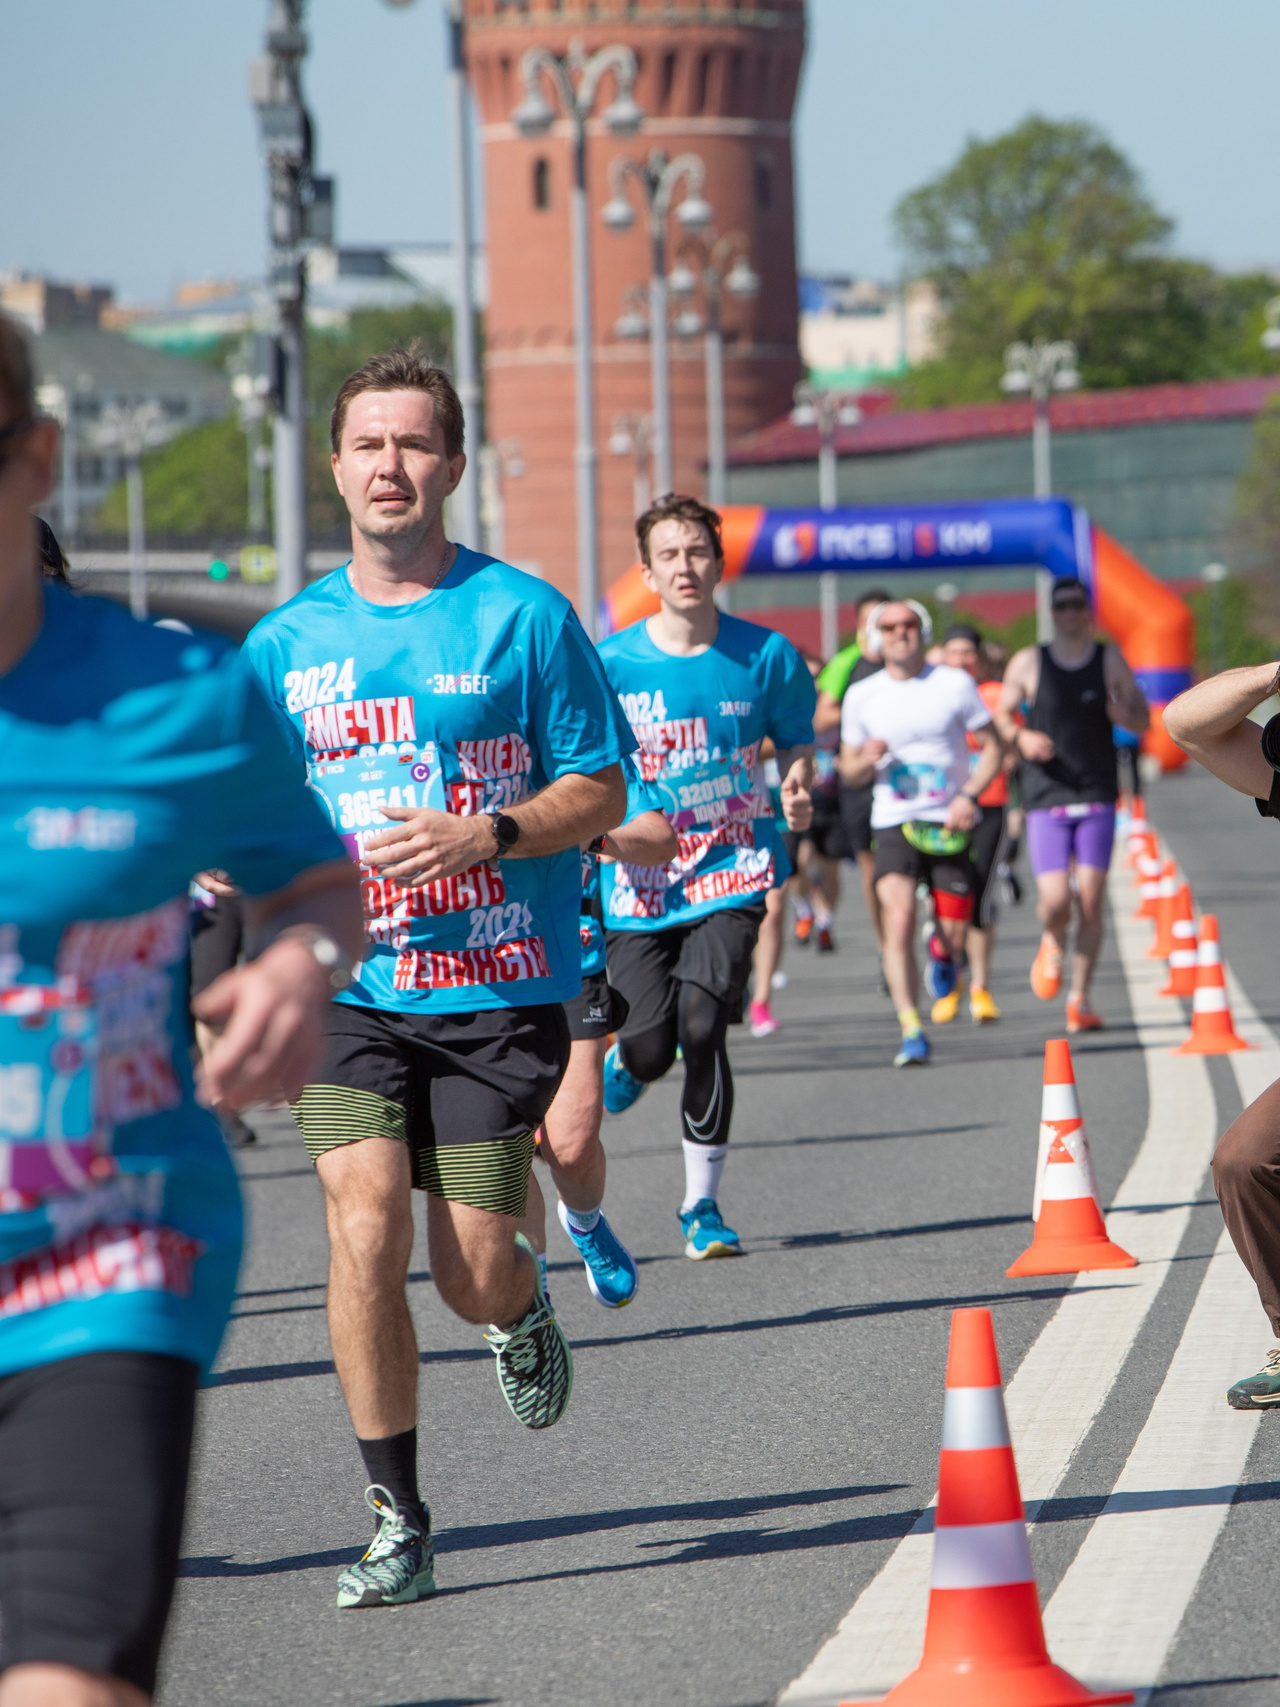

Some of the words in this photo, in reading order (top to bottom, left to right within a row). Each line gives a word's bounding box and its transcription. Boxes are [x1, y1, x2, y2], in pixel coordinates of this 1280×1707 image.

[284, 657, 357, 714] 2024
[678, 774, 733, 808] 32016
[361, 864, 505, 918] ОРДОСТЬ
